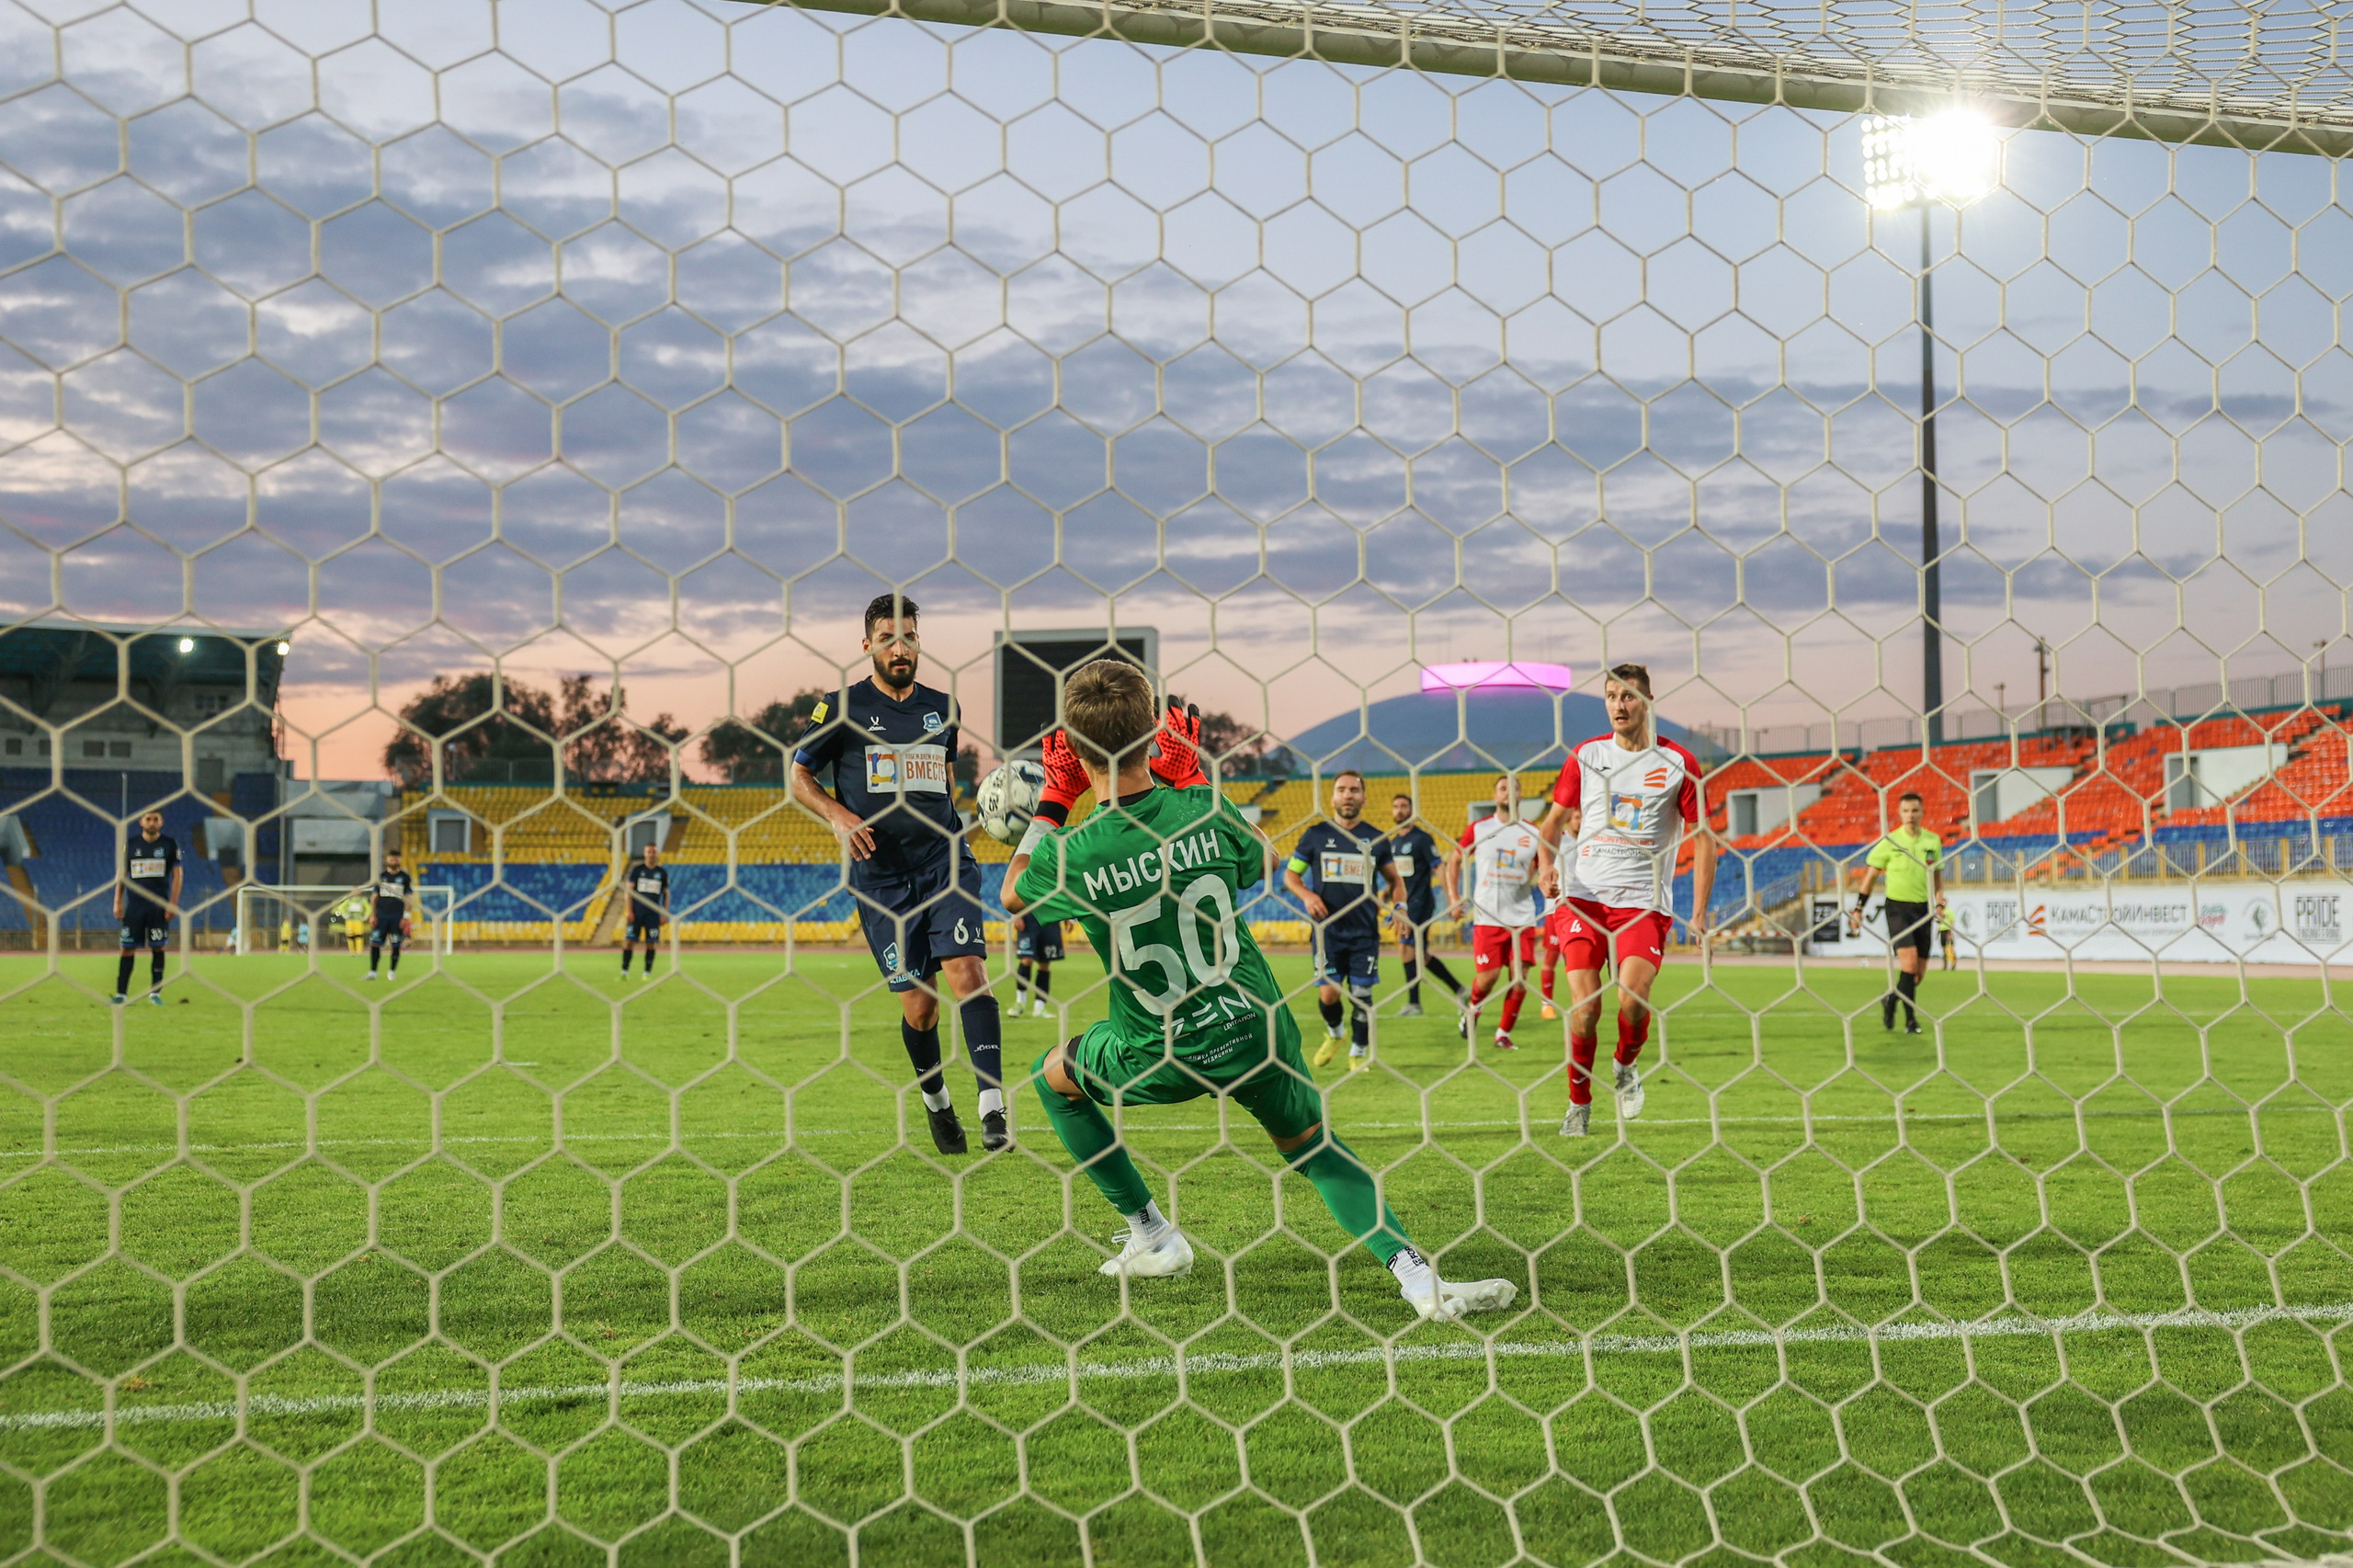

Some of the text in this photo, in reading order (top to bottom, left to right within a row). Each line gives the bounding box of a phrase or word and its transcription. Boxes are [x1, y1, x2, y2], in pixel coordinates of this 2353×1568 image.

[905, 761, 946, 782] ВМЕСТЕ
[1593, 846, 1652, 858] КАМАСТРОЙИН
[1083, 828, 1221, 901] МЫСКИН
[2296, 895, 2341, 927] PRIDE
[954, 917, 969, 945] 6
[1570, 919, 1582, 933] 4
[1108, 874, 1240, 1016] 50
[1202, 1046, 1233, 1064] МЕДИЦИНЫ
[1209, 1032, 1253, 1055] ПРЕВЕНТИВНОЙ
